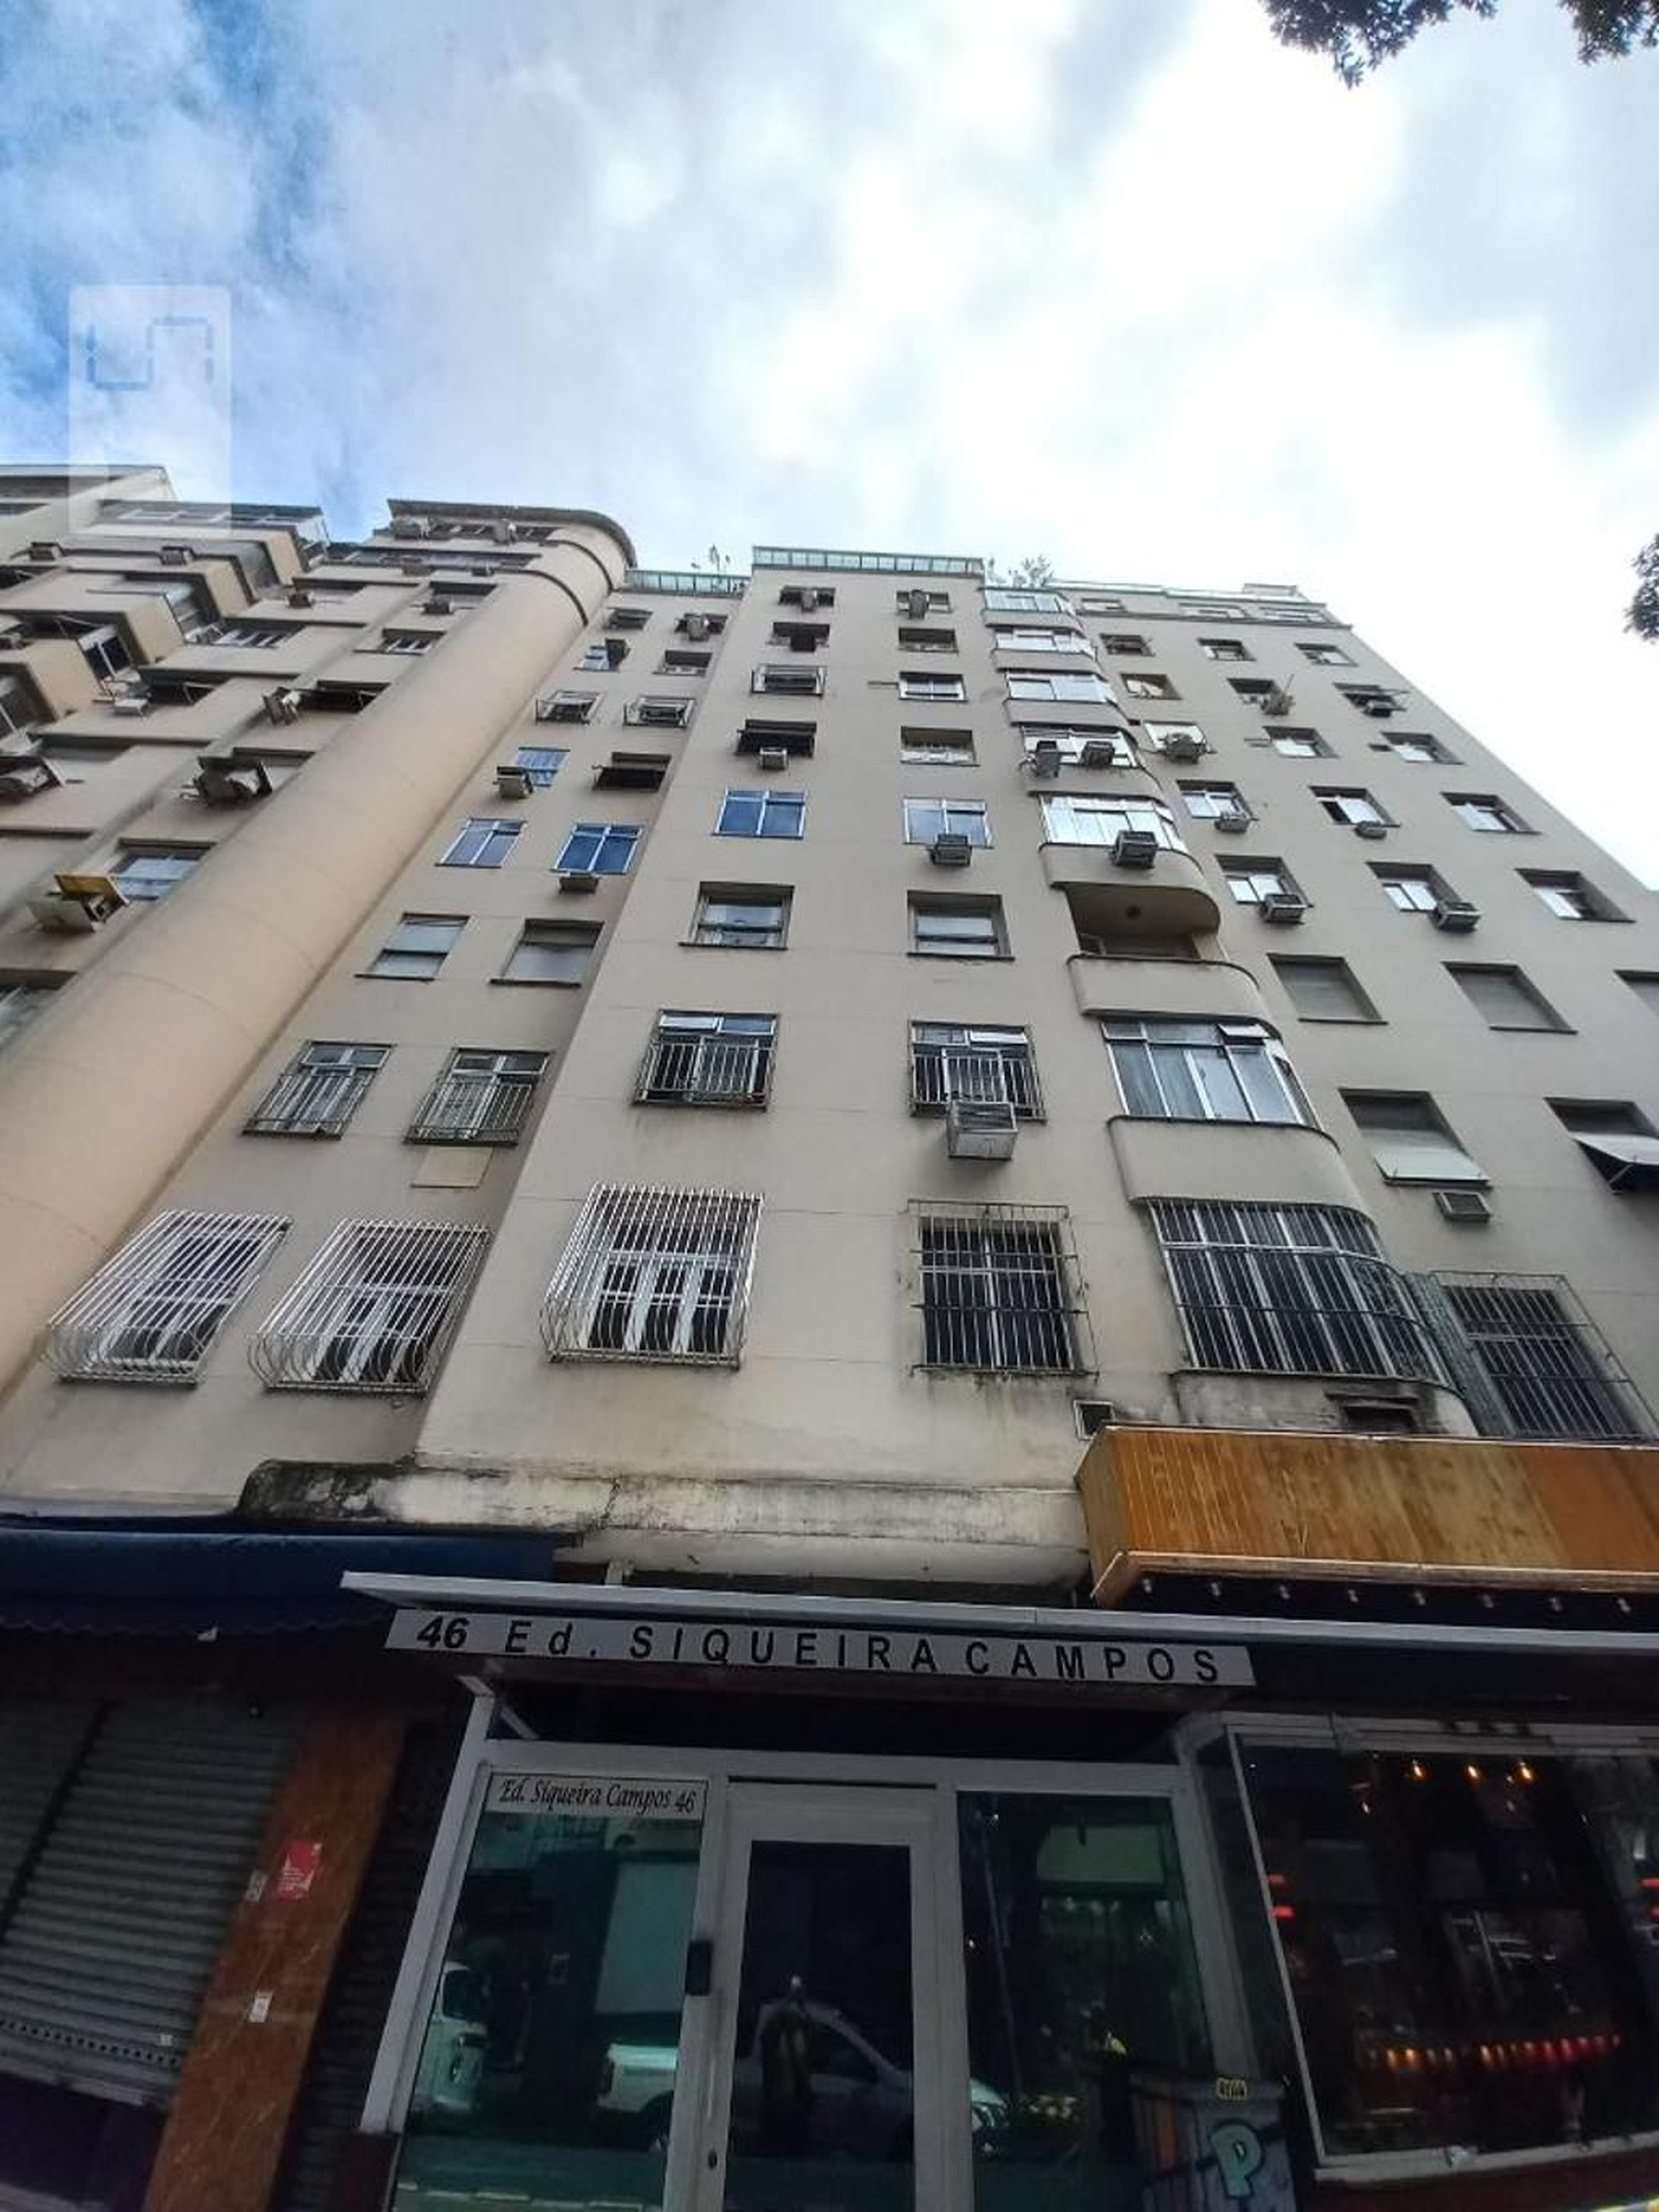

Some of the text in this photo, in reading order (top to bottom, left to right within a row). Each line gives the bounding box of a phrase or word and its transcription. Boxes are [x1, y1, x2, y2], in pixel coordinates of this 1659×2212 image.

[416, 1616, 1218, 1683] 46 Ed. SIQUEIRA CAMPOS
[499, 1779, 696, 1814] Ed. Siqueira Campos 46
